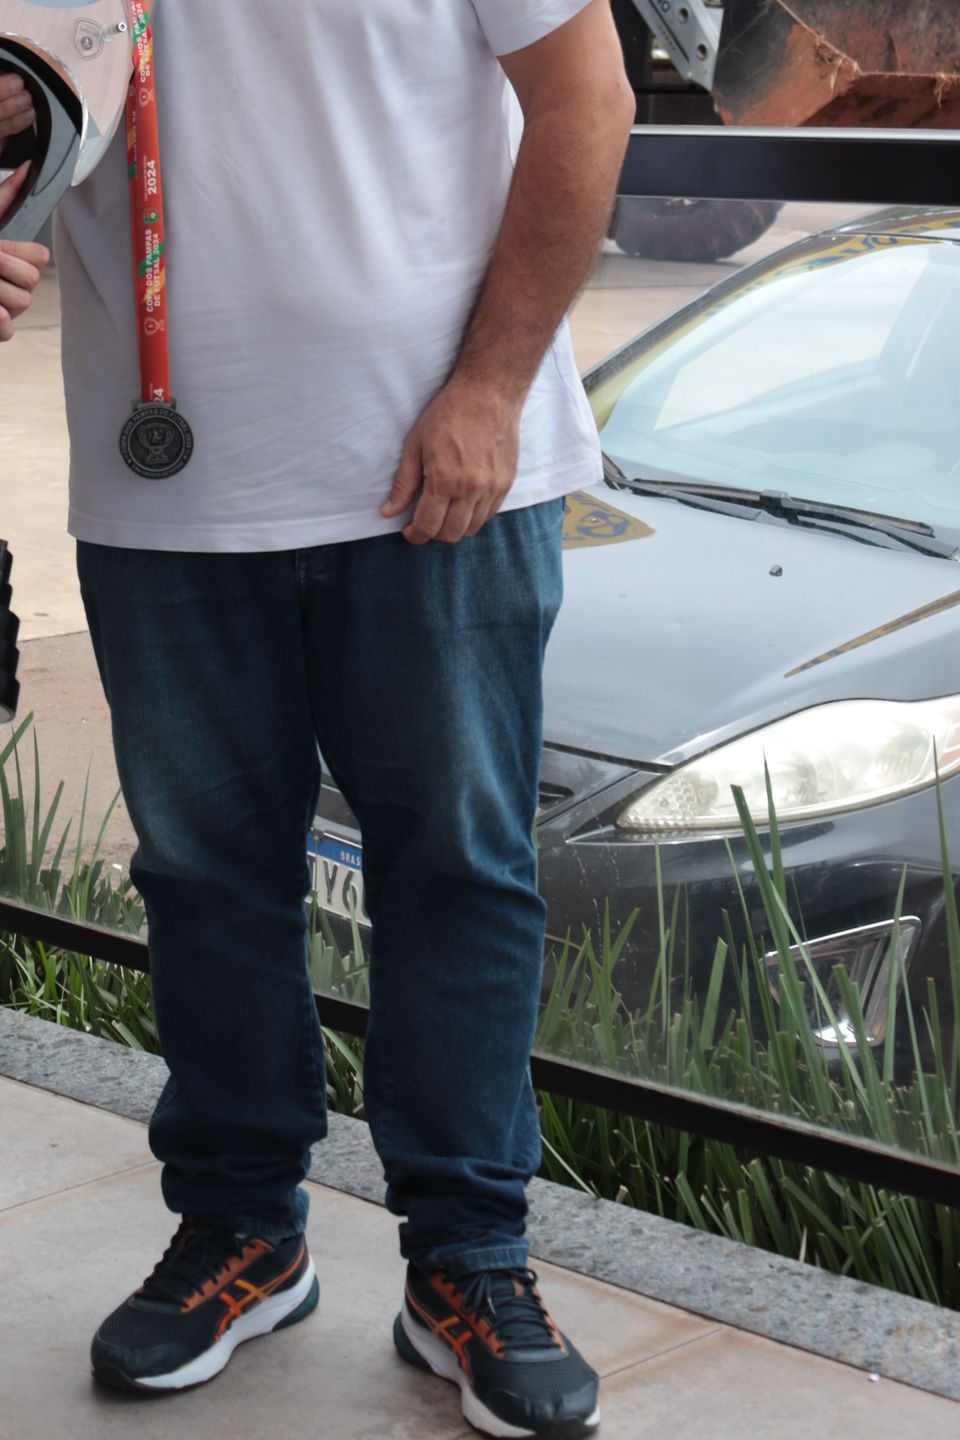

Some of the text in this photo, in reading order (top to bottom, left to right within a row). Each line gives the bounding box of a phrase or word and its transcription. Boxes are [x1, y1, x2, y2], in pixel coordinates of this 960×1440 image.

[136, 2, 145, 25] 2024
[148, 160, 157, 195] 2024
[153, 257, 161, 292] FUTSAL
[153, 294, 161, 307] DE
